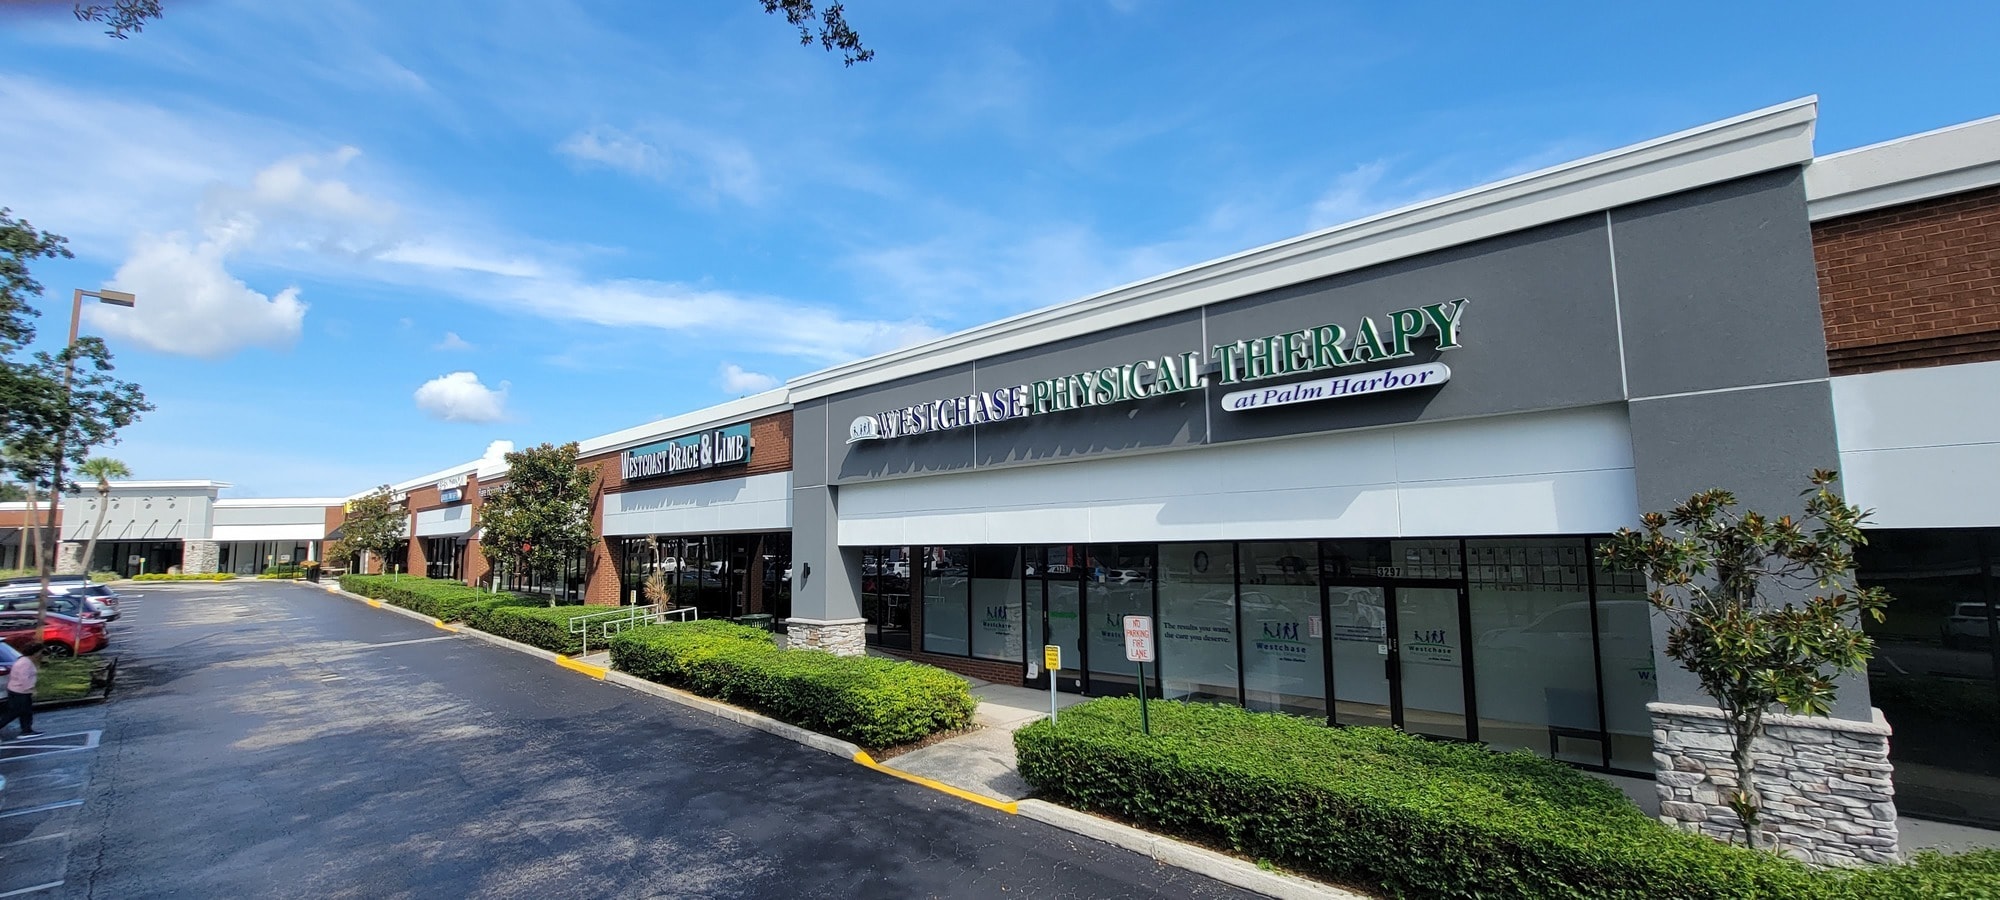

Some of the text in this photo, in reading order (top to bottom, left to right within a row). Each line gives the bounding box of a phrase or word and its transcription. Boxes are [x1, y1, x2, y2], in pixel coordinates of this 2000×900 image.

[876, 298, 1469, 439] WESTCHASE PHYSICAL THERAPY
[1234, 368, 1434, 409] at Palm Harbor
[620, 431, 744, 480] WESTCOAST BRACE & LIMB
[1377, 566, 1401, 577] 3297
[1132, 619, 1141, 628] NO
[1163, 622, 1176, 630] The
[1126, 629, 1150, 639] PARKING
[1164, 631, 1174, 639] the
[1132, 639, 1145, 648] FIRE
[1256, 642, 1306, 654] Westchase
[1130, 649, 1148, 658] LANE
[1408, 645, 1452, 654] Westchase
